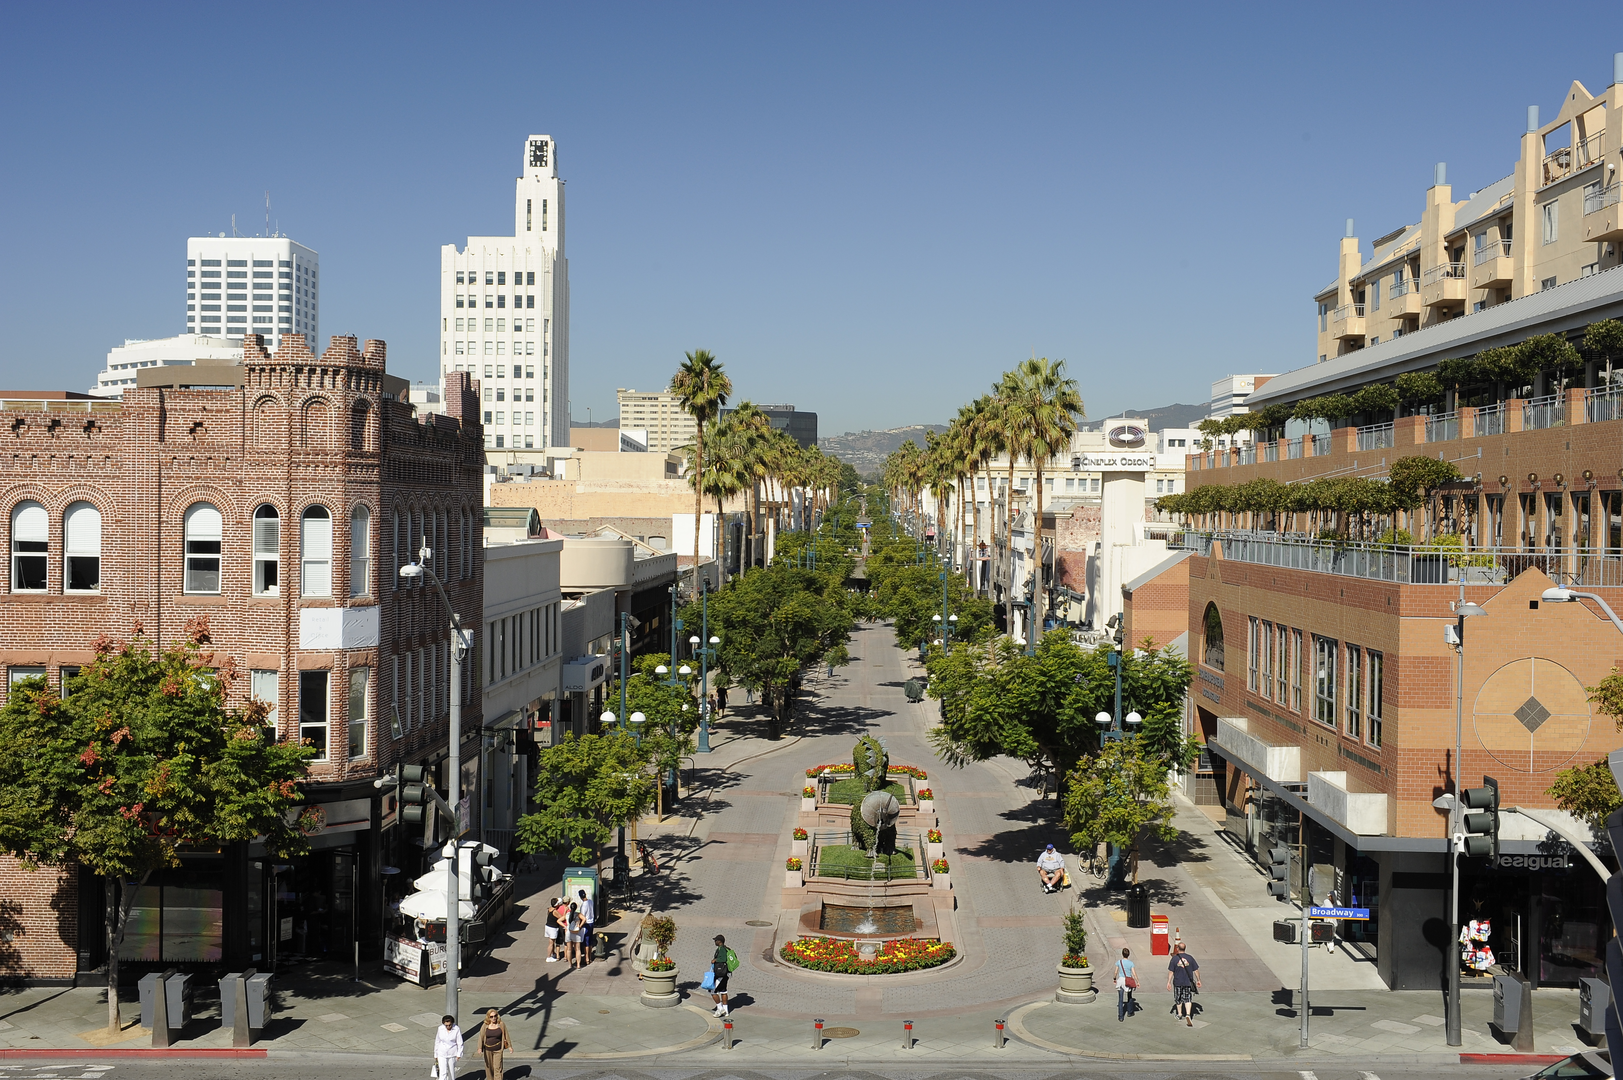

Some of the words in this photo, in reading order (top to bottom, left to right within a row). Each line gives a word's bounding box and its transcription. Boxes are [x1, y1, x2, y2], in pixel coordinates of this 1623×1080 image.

[1082, 458, 1117, 466] CINEPLEX
[1120, 457, 1148, 466] ODEON
[1497, 854, 1568, 870] esigual
[1312, 908, 1354, 917] Broadway
